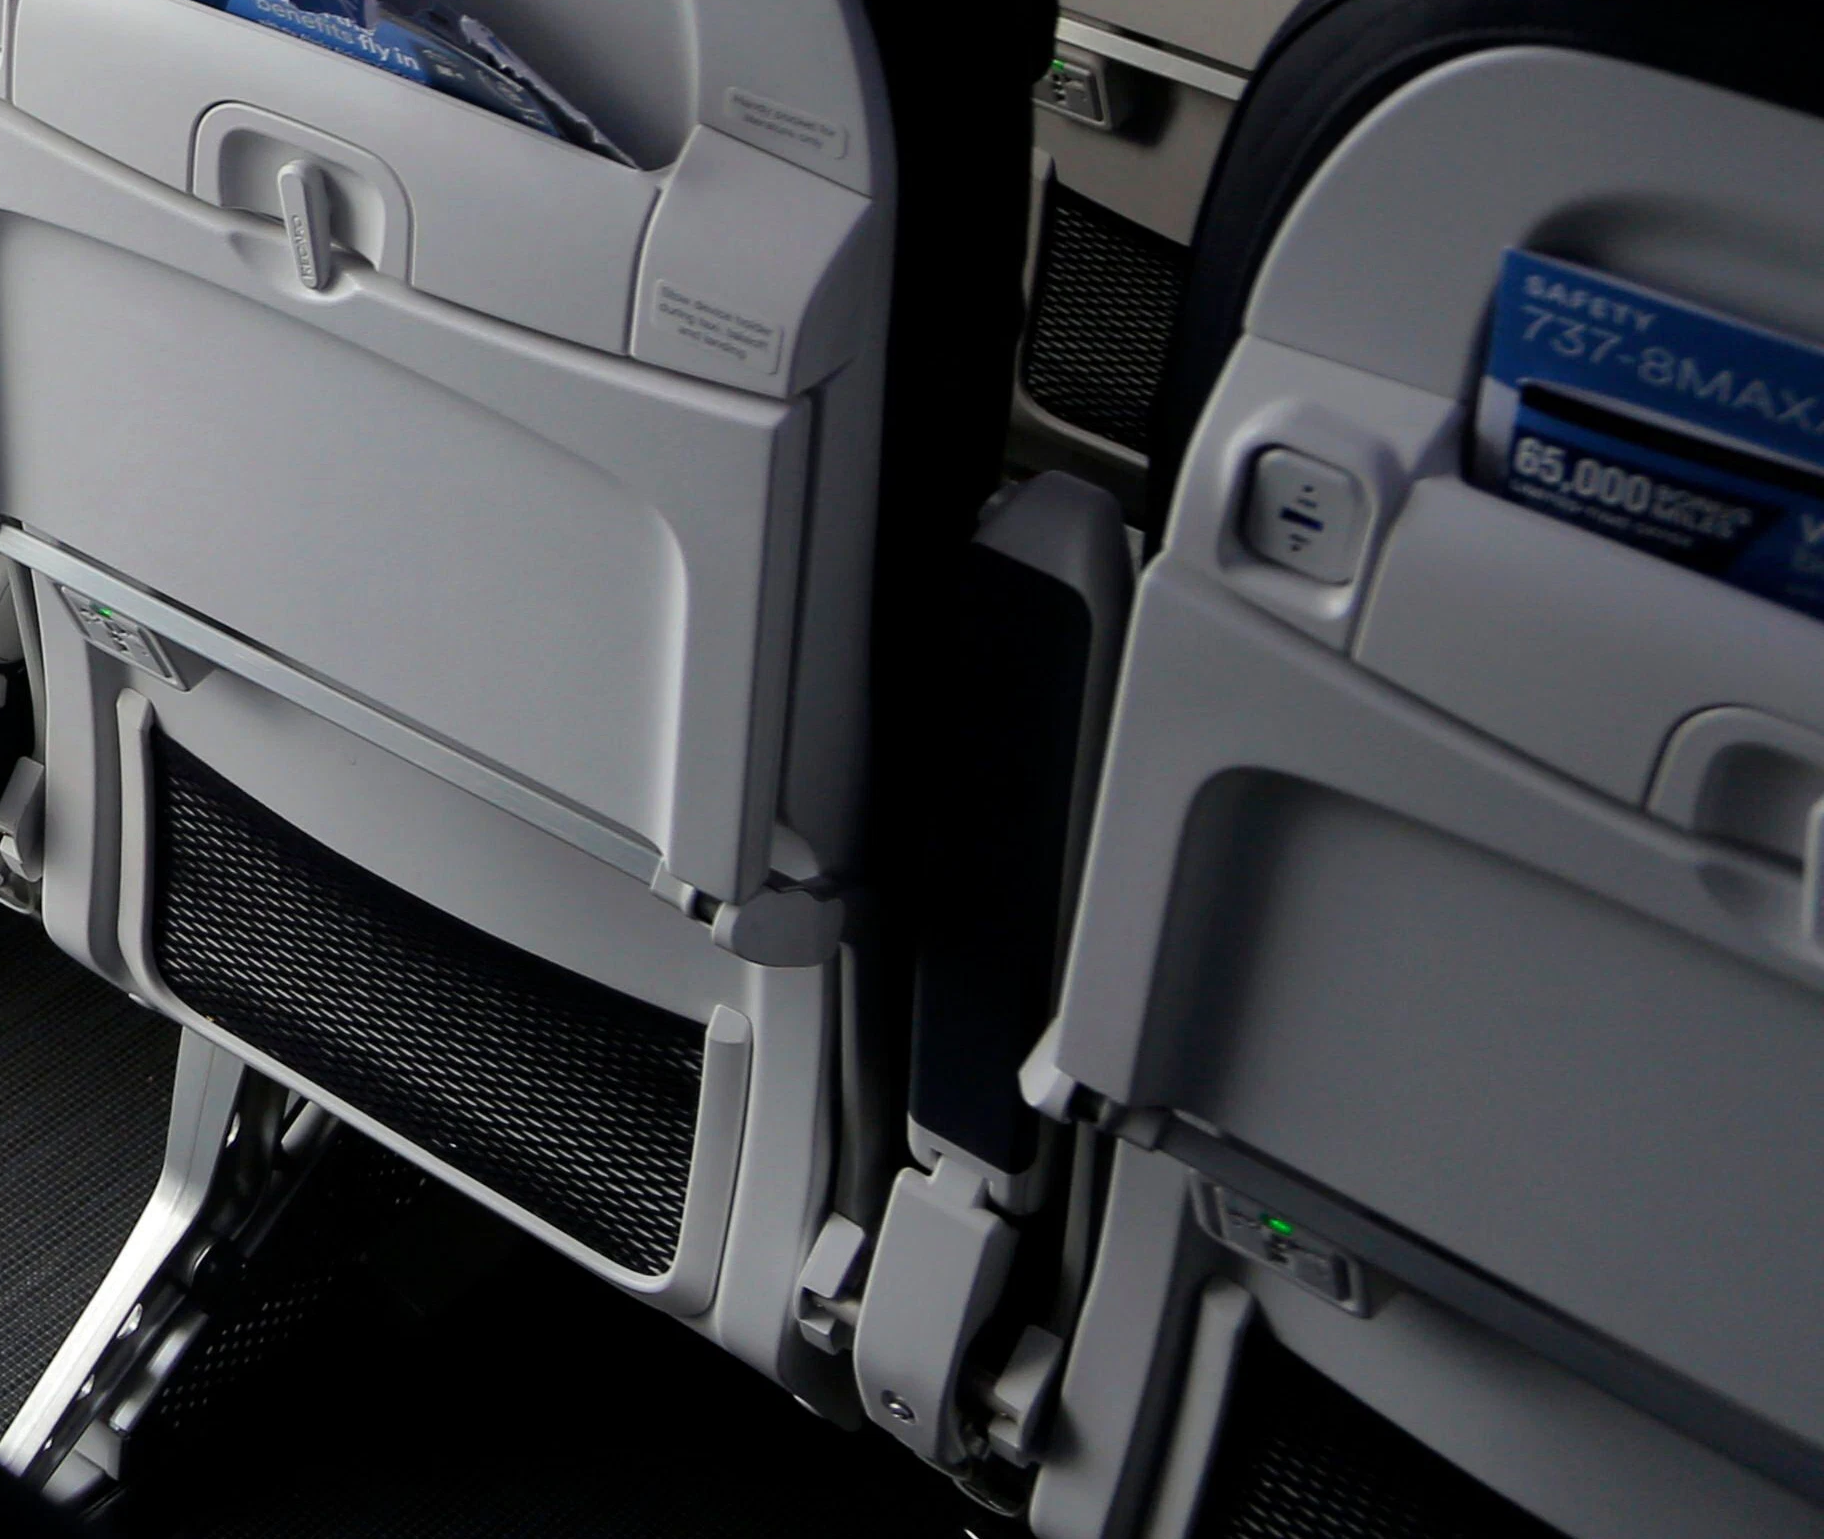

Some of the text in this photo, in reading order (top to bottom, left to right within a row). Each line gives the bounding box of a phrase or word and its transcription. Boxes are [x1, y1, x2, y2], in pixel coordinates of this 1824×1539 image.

[358, 31, 391, 63] fly
[391, 45, 421, 72] in
[1522, 273, 1658, 333] SAFETY
[1512, 434, 1654, 516] 65,000
